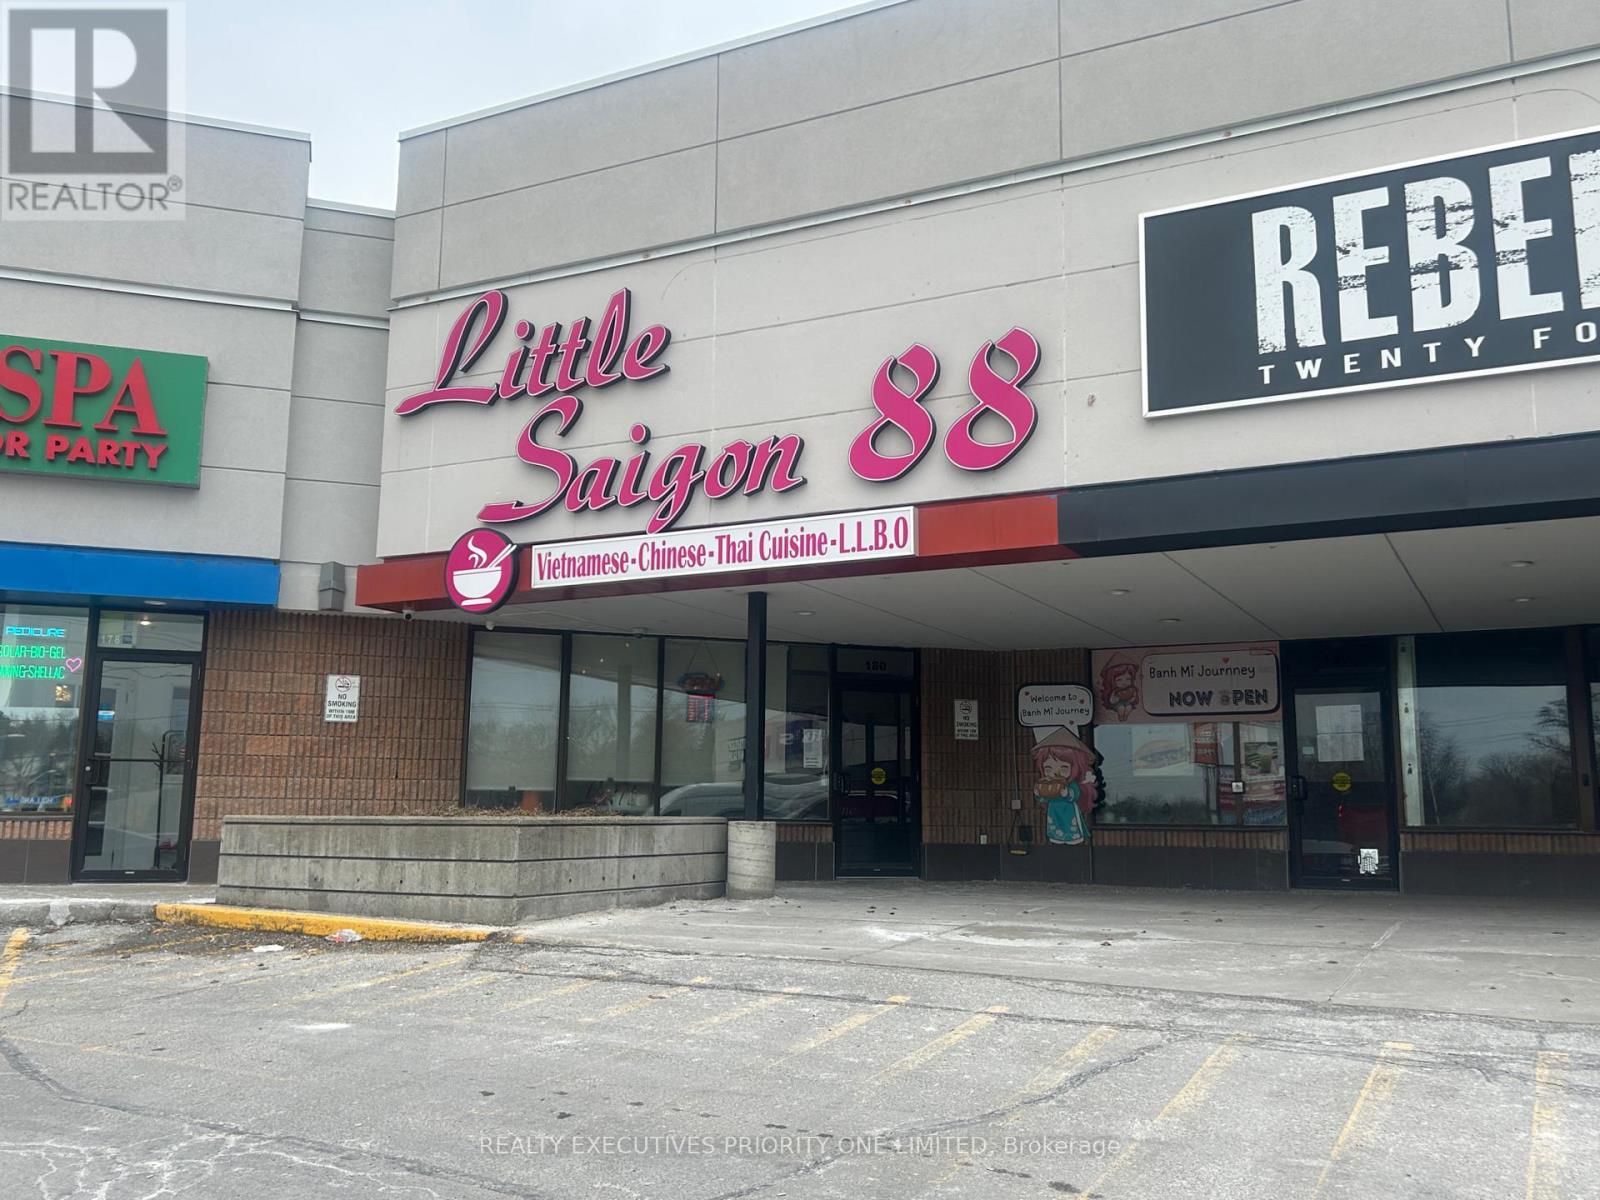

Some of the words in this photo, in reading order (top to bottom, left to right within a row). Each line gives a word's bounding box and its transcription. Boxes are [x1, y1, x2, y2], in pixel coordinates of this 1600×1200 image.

[394, 287, 672, 416] Little
[1258, 336, 1485, 384] TWENTY
[0, 345, 168, 437] SPA
[477, 395, 808, 535] Saigon
[848, 326, 1041, 482] 88
[45, 434, 169, 470] PARTY
[1149, 666, 1177, 679] Banh
[1198, 664, 1256, 679] Journney
[327, 700, 357, 708] SMOKING
[1030, 694, 1066, 702] Welcome
[1169, 689, 1213, 708] NOW
[1022, 708, 1041, 717] Banh
